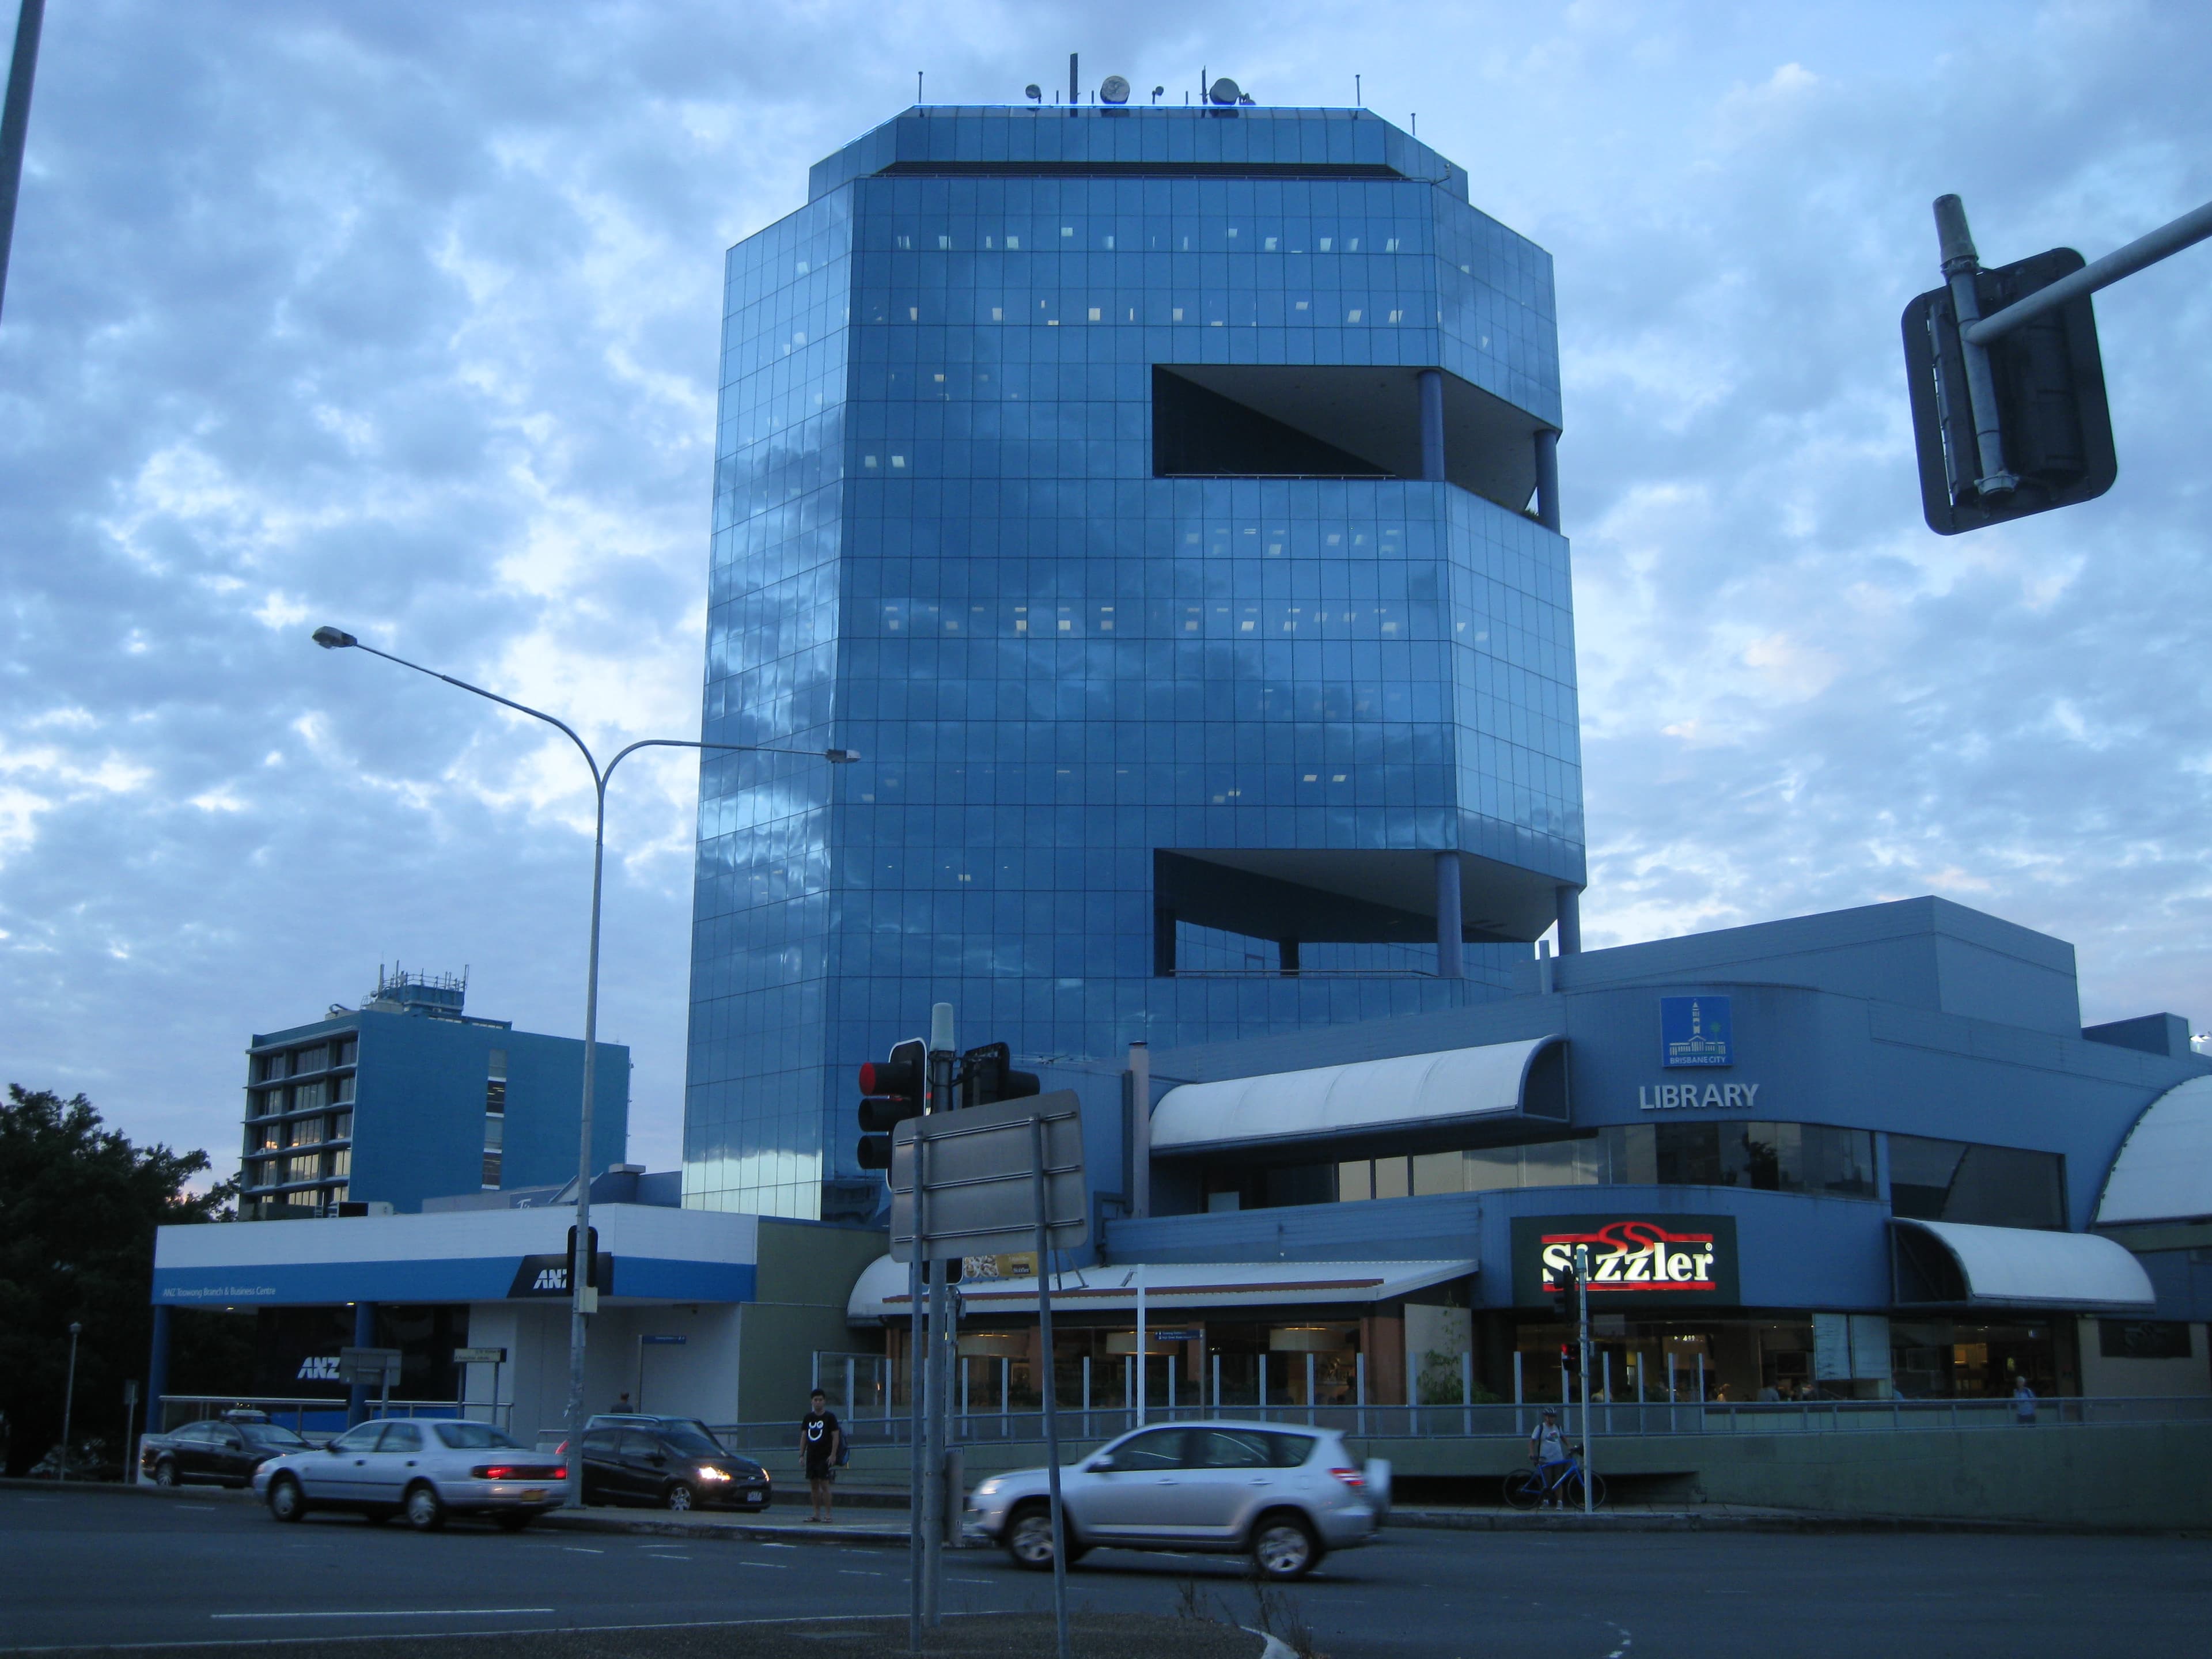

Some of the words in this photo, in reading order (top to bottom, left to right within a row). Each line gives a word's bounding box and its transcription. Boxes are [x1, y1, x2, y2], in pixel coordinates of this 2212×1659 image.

[1639, 1084, 1759, 1109] LIBRARY
[1541, 1241, 1714, 1282] Sizzler
[162, 1288, 176, 1297] ANZ
[203, 1287, 224, 1296] Branch
[224, 1287, 229, 1296] &
[230, 1286, 255, 1296] Business
[256, 1286, 276, 1296] Centre
[297, 1357, 341, 1378] ANZ
